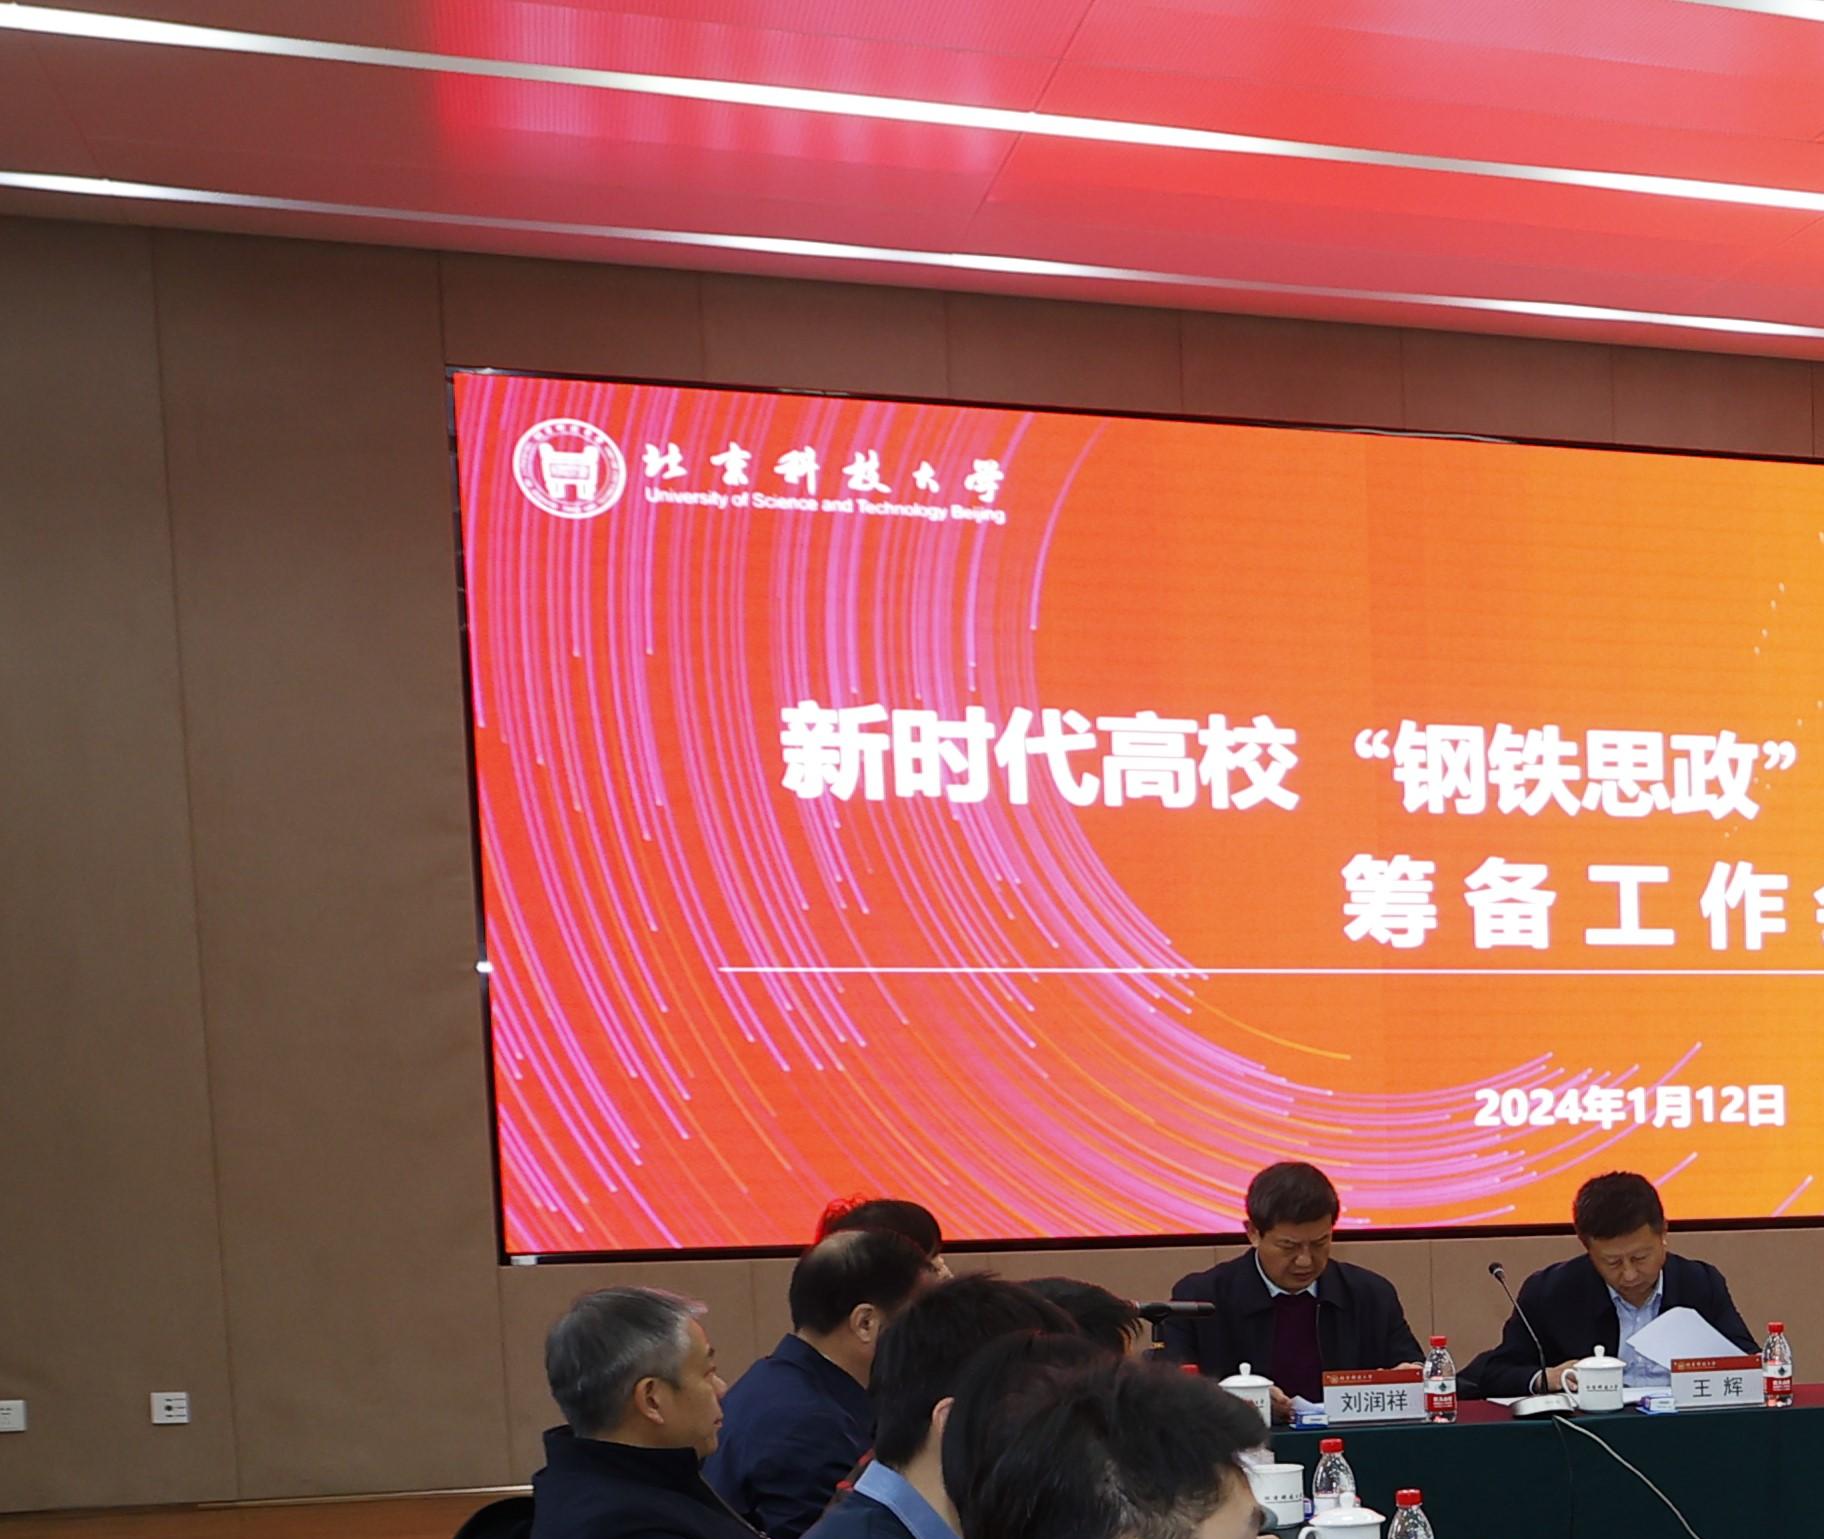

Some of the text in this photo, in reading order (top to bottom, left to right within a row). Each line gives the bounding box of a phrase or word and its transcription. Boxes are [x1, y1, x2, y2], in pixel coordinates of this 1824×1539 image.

[643, 441, 1005, 503] 北京科技大学
[646, 486, 1007, 525] University of Science and Technology Beijing
[1475, 1085, 1785, 1129] 2024年1月12日
[1341, 1390, 1408, 1413] 刘润祥
